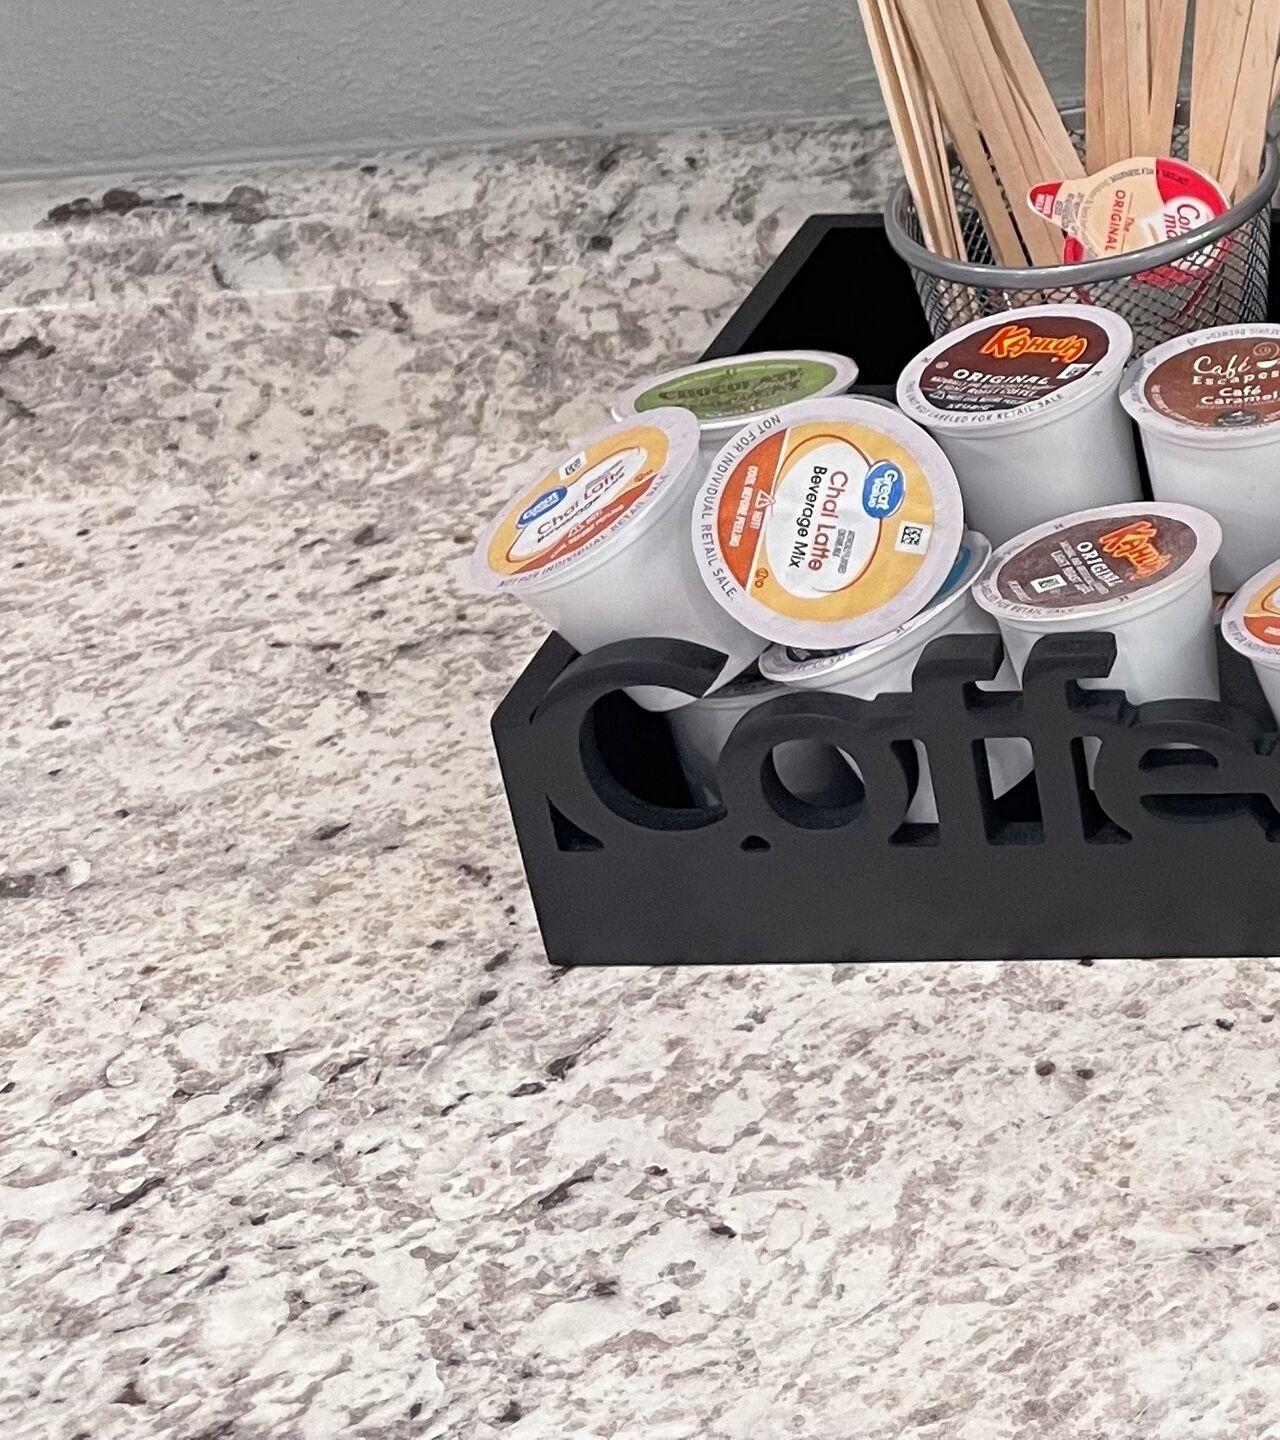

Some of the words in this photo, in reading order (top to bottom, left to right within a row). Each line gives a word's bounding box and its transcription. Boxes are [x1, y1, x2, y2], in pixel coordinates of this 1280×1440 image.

[1104, 189, 1126, 252] ORIGINAL
[1123, 216, 1136, 233] The
[953, 369, 1051, 385] ORIGINAL
[1193, 354, 1252, 379] Café
[1219, 385, 1262, 397] Café
[732, 431, 756, 453] FOR
[757, 414, 782, 435] NOT
[700, 451, 737, 520] INDIVIDUAL
[796, 465, 828, 538] Beverage
[820, 470, 849, 520] Chai
[875, 468, 899, 511] Great
[700, 523, 716, 566] RETAIL
[788, 539, 810, 569] Mix
[808, 522, 837, 572] Latte
